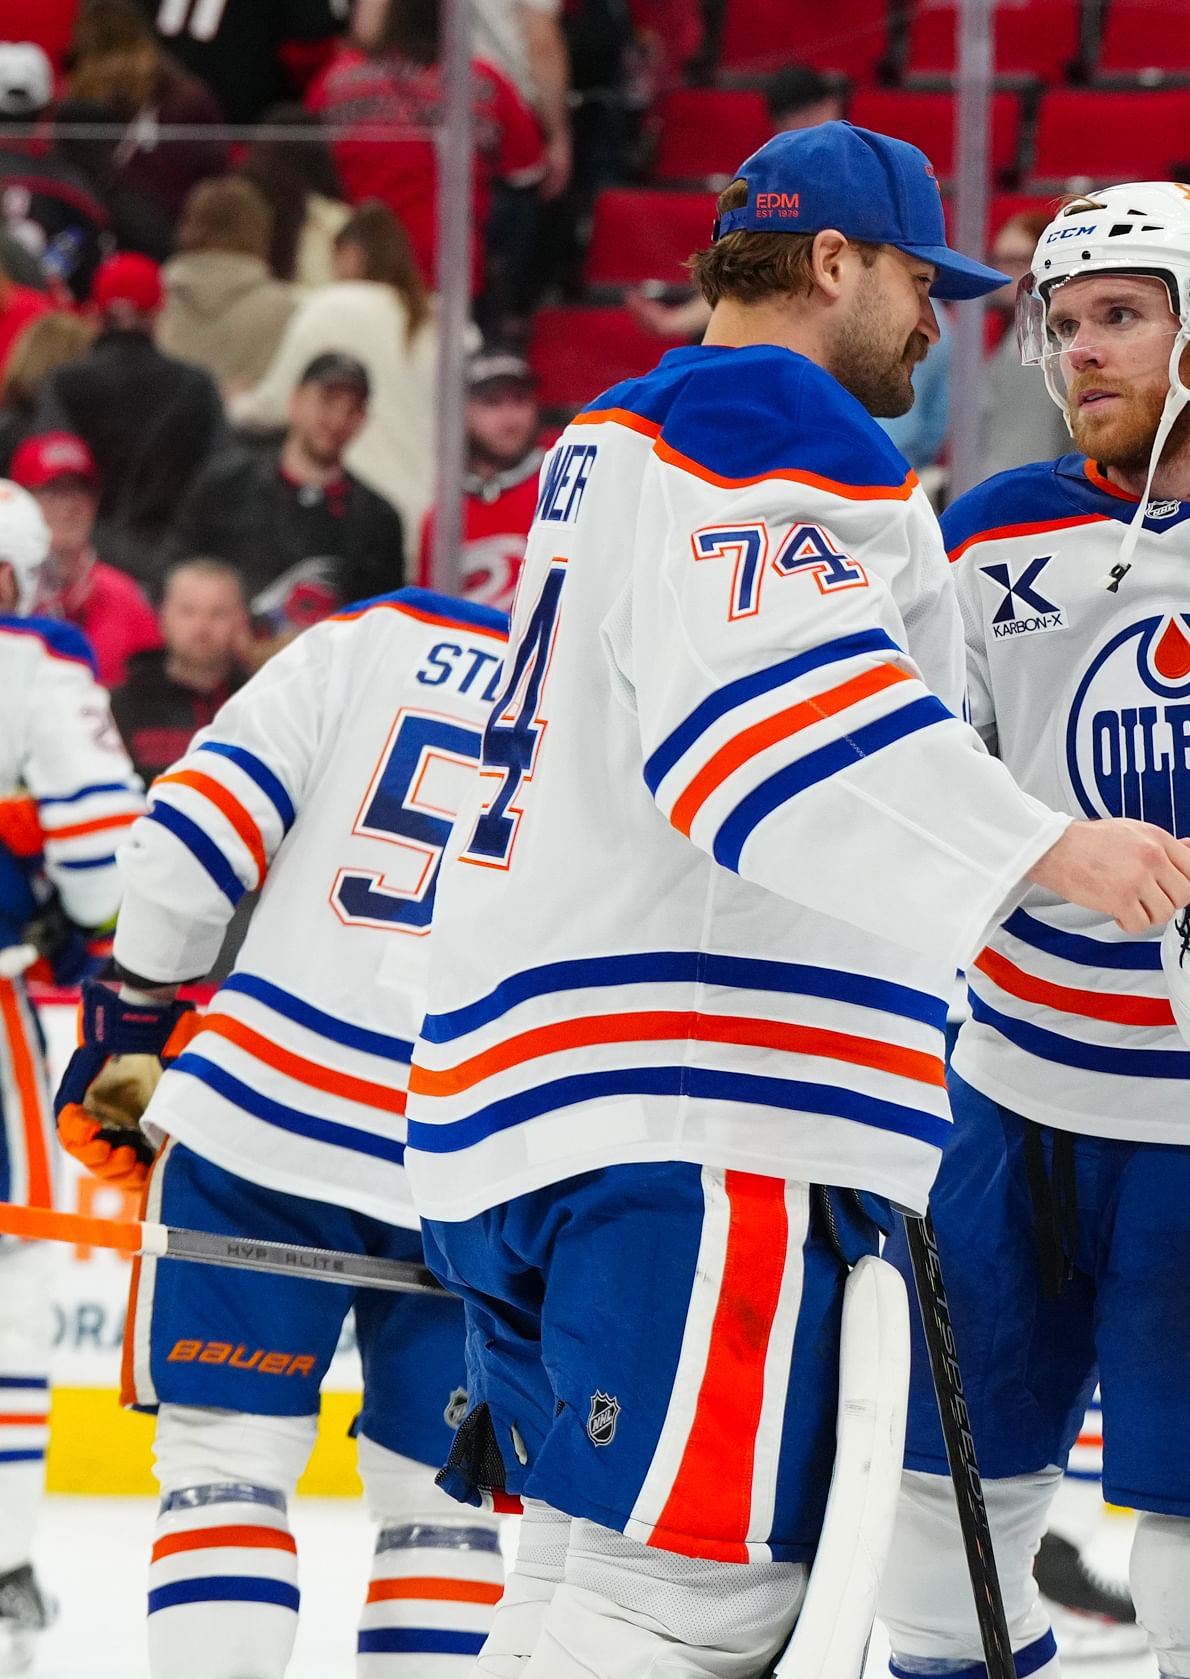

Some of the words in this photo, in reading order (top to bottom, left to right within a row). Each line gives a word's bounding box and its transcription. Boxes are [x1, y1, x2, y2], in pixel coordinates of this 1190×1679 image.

[755, 192, 800, 209] EDM
[755, 209, 773, 218] EST
[778, 209, 800, 218] 1979
[1045, 224, 1098, 244] CCM
[691, 520, 869, 622] 74
[992, 613, 1064, 638] KARBON-X
[457, 556, 568, 871] 4
[166, 1338, 317, 1377] BAUER
[592, 1408, 614, 1432] NHL
